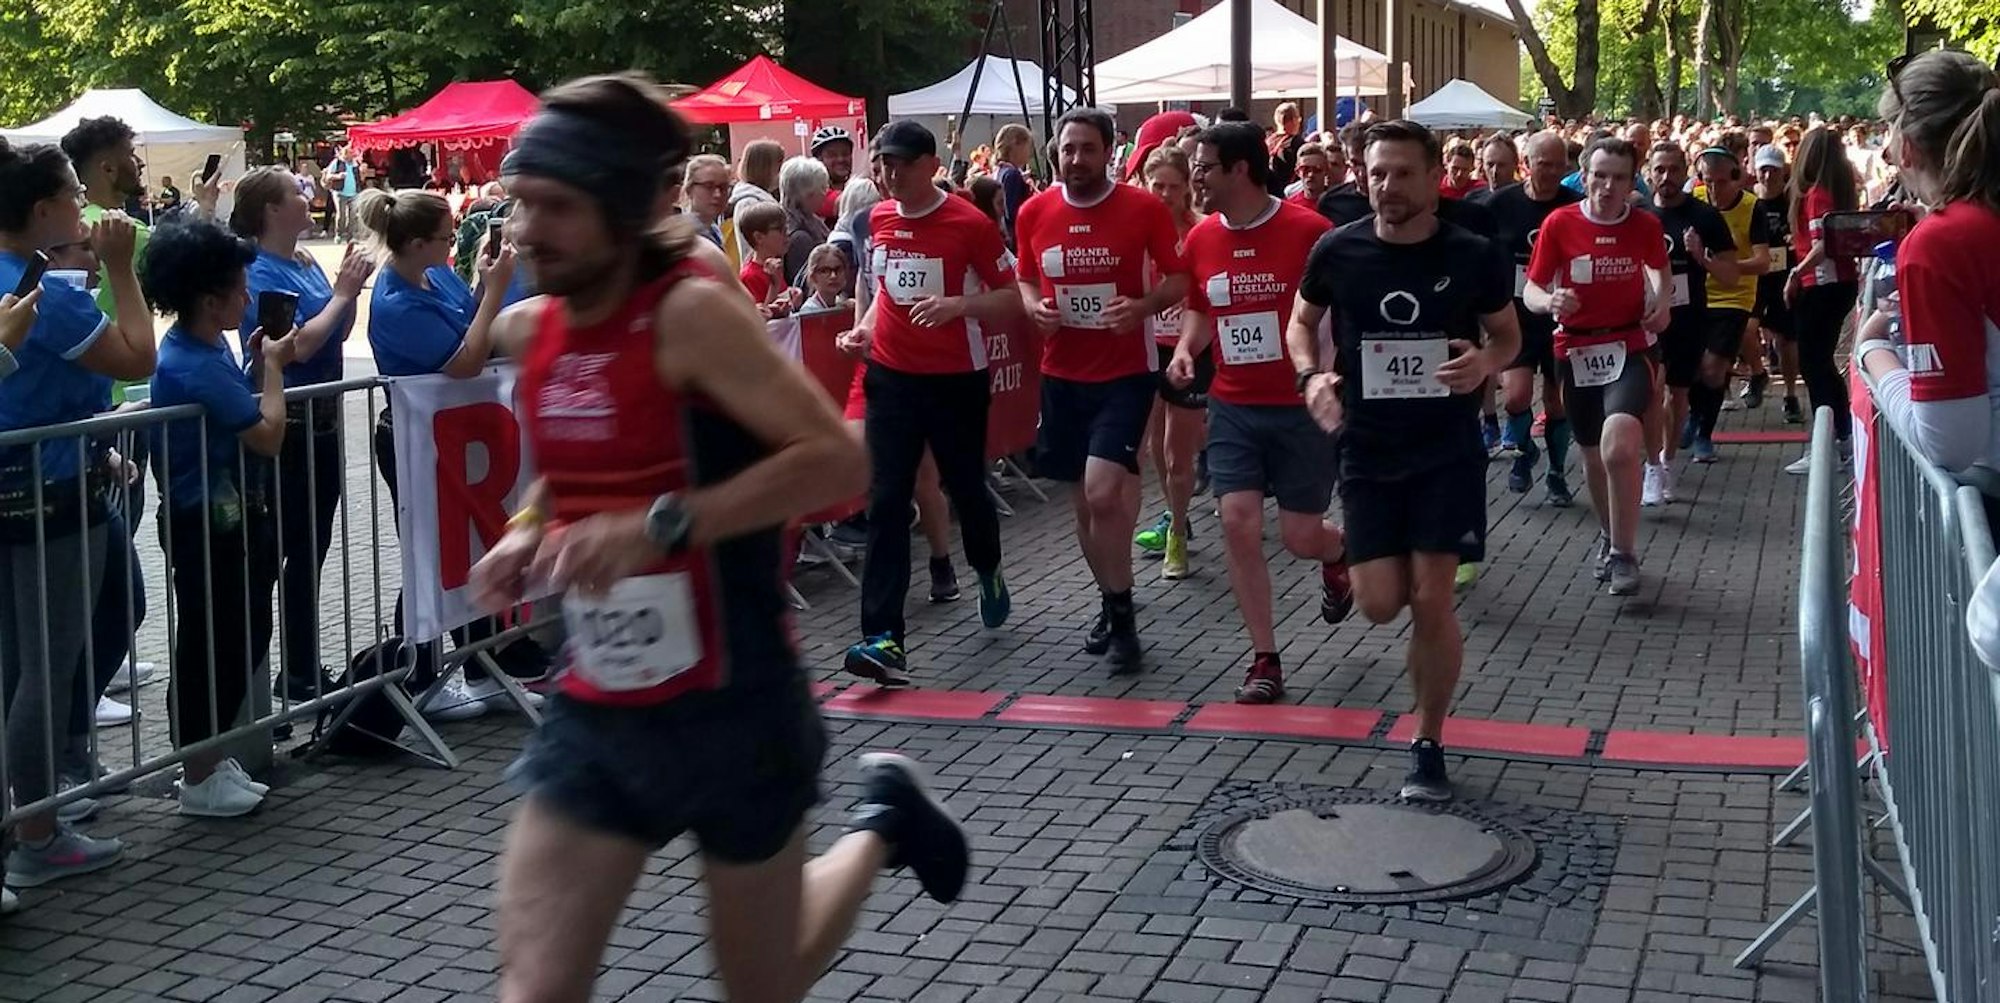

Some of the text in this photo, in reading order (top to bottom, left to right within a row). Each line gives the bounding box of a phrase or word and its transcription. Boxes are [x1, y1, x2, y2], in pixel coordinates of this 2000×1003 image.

[1069, 225, 1091, 233] REWE
[1067, 247, 1110, 257] KÖLNER
[1233, 249, 1255, 258] REWE
[1067, 256, 1121, 267] LESELAUF
[1595, 256, 1632, 266] KÖLNER
[898, 271, 927, 287] 837
[1232, 273, 1275, 284] KÖLNER
[1232, 283, 1287, 294] LESELAUF
[1071, 297, 1101, 312] 505
[1231, 327, 1263, 346] 504
[1386, 356, 1424, 376] 412
[1584, 354, 1616, 371] 1414
[990, 363, 1023, 395] AUF
